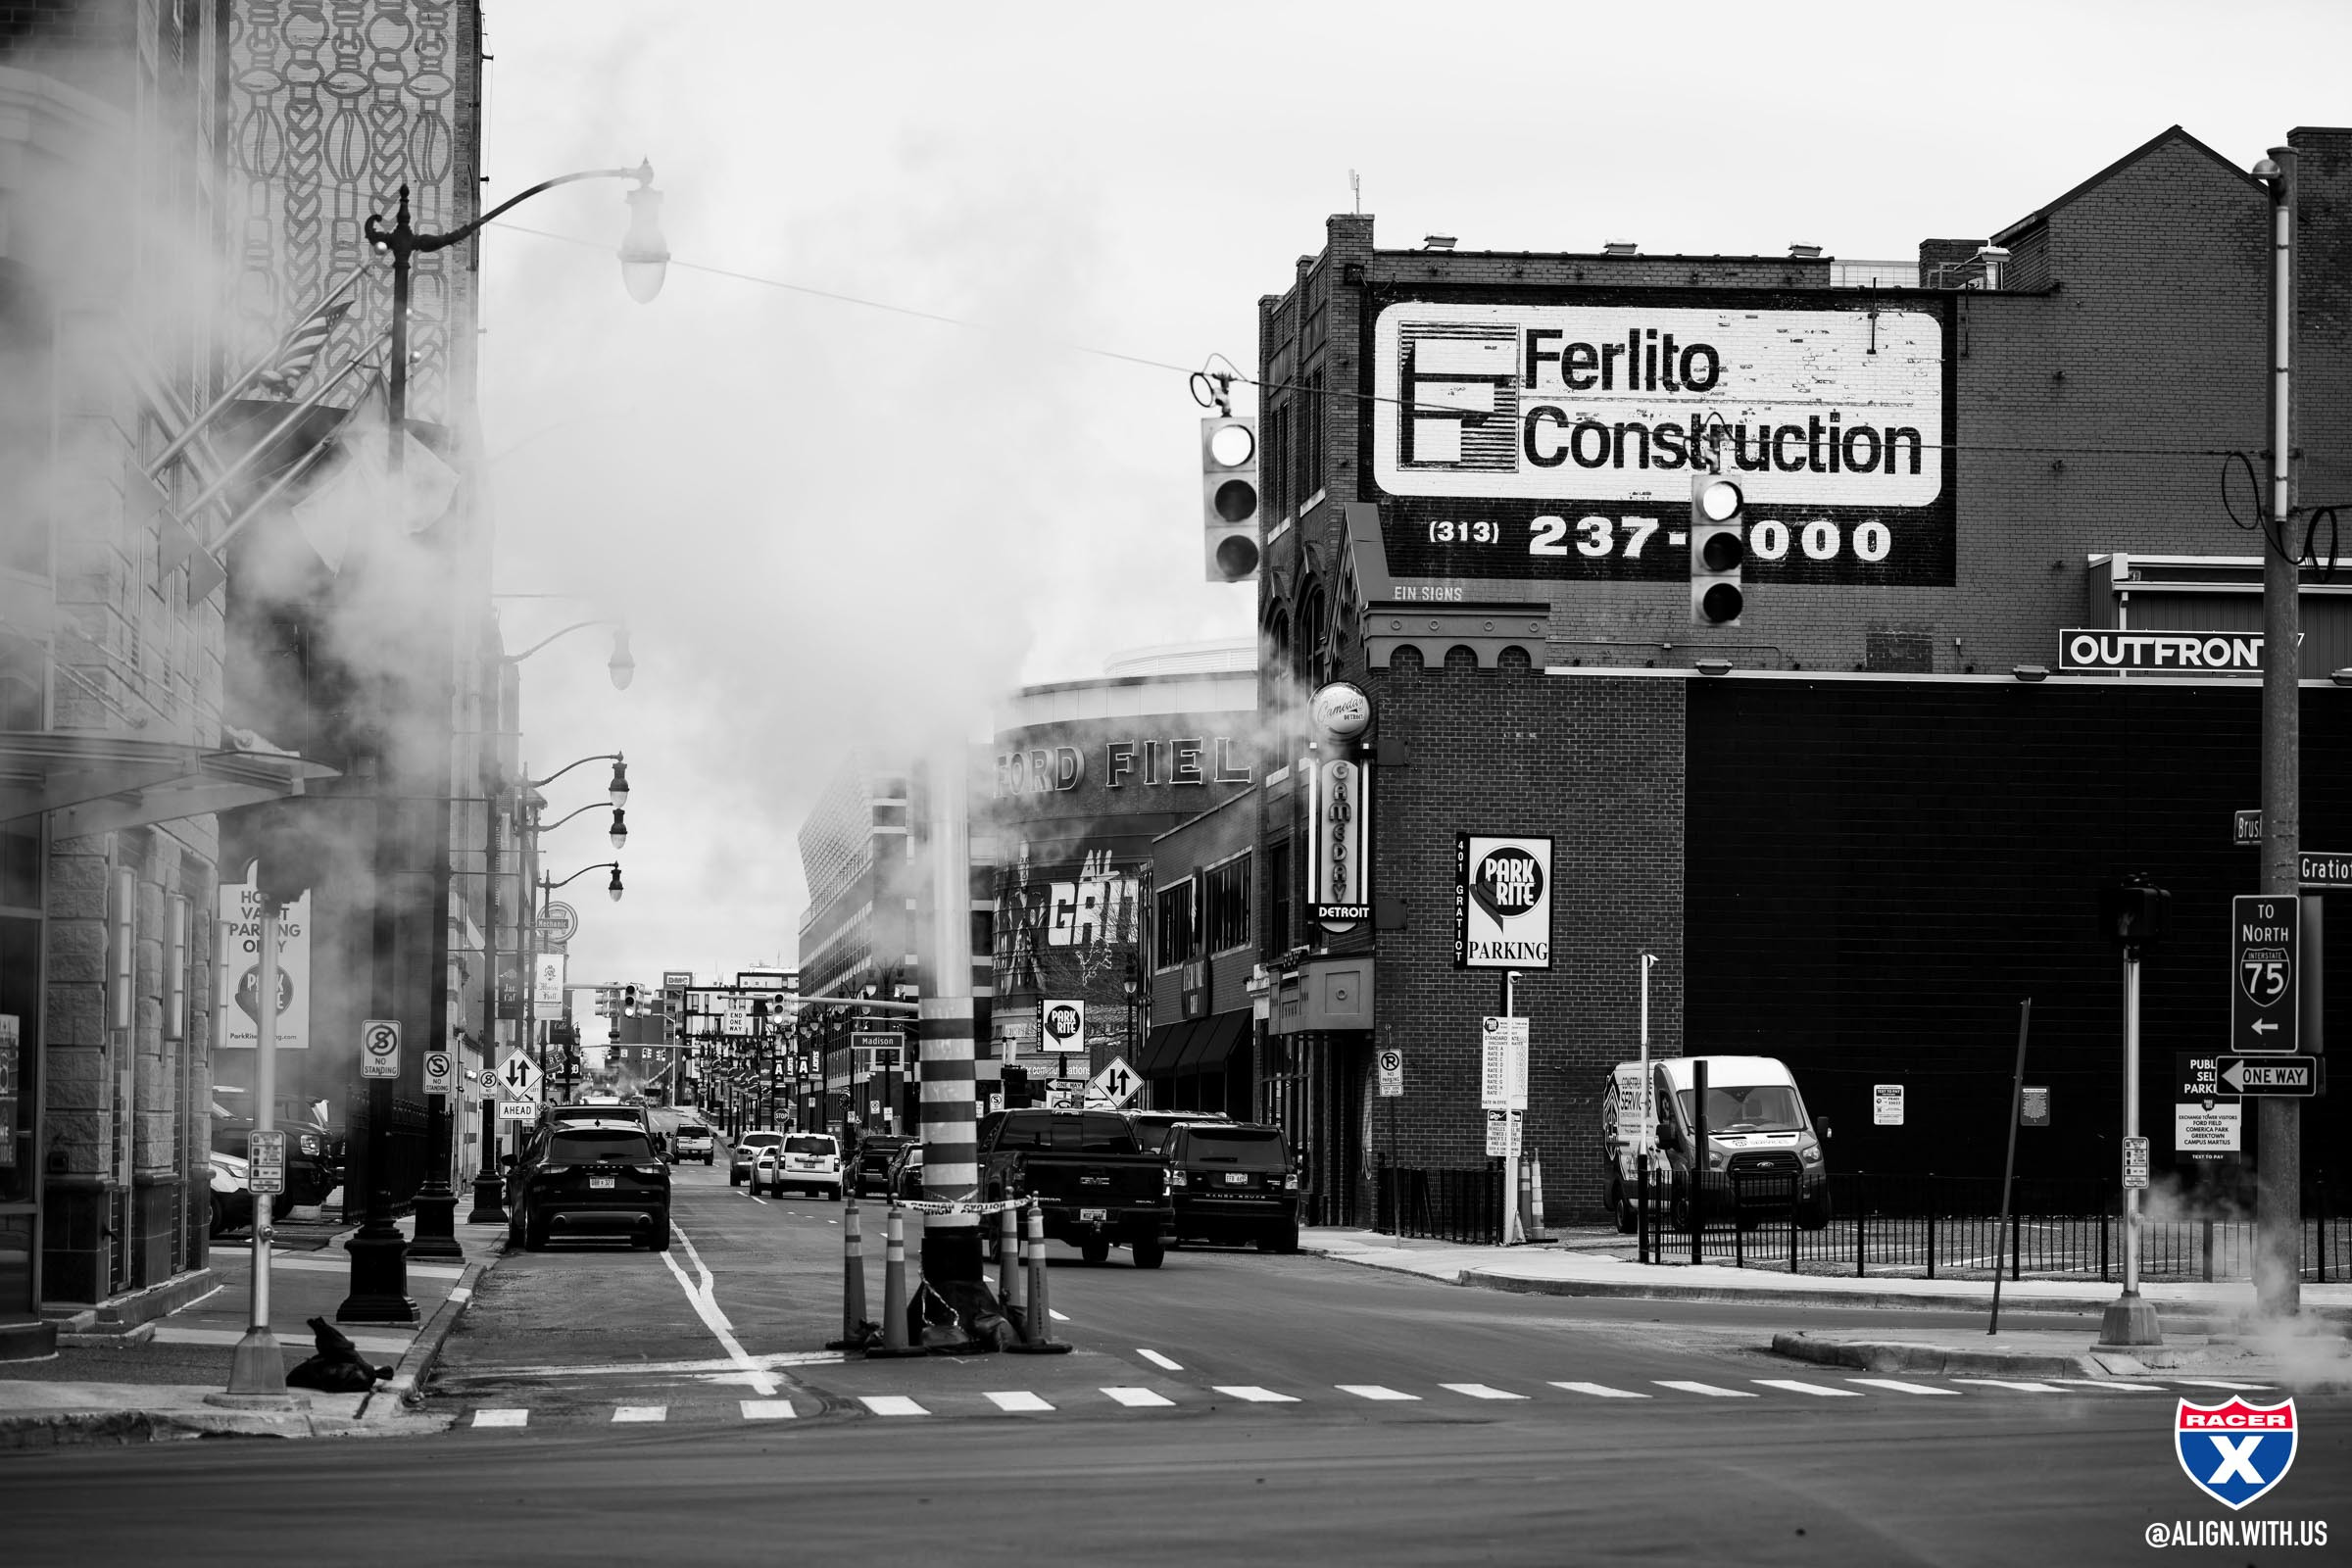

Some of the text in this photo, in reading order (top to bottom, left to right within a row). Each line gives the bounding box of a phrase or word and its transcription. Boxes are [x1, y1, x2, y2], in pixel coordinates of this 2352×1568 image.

[1526, 328, 1720, 392] Ferlito
[1523, 404, 1922, 475] Construction
[1429, 514, 1892, 563] (313) 237-000
[1422, 586, 1462, 601] SIGNS
[994, 746, 1086, 799] FORD
[1328, 761, 1351, 902] GAMEDAY
[1079, 850, 1120, 882] ALL
[1485, 858, 1535, 882] PARK
[1496, 882, 1536, 906] RITE
[1318, 907, 1370, 918] DETROIT
[2258, 904, 2275, 918] TO
[229, 923, 301, 937] PARNG
[538, 919, 566, 928] Mechanic
[1455, 885, 1464, 961] GRATIOT
[2242, 924, 2289, 942] NORTH
[1469, 941, 1548, 960] PARKING
[2248, 952, 2282, 960] INTERSTATE
[2245, 962, 2284, 994] 75
[1052, 1010, 1076, 1022] PARK
[1057, 1022, 1076, 1033] RITE
[862, 1037, 894, 1046] Madison
[1032, 1062, 1090, 1076] commucations
[2190, 1059, 2216, 1069] PUBL
[2197, 1072, 2216, 1081] SEL
[2243, 1069, 2304, 1084] ONE WAY
[1621, 1091, 1651, 1110] SERVICS
[504, 1106, 531, 1115] AHEAD
[776, 1110, 788, 1119] STOP
